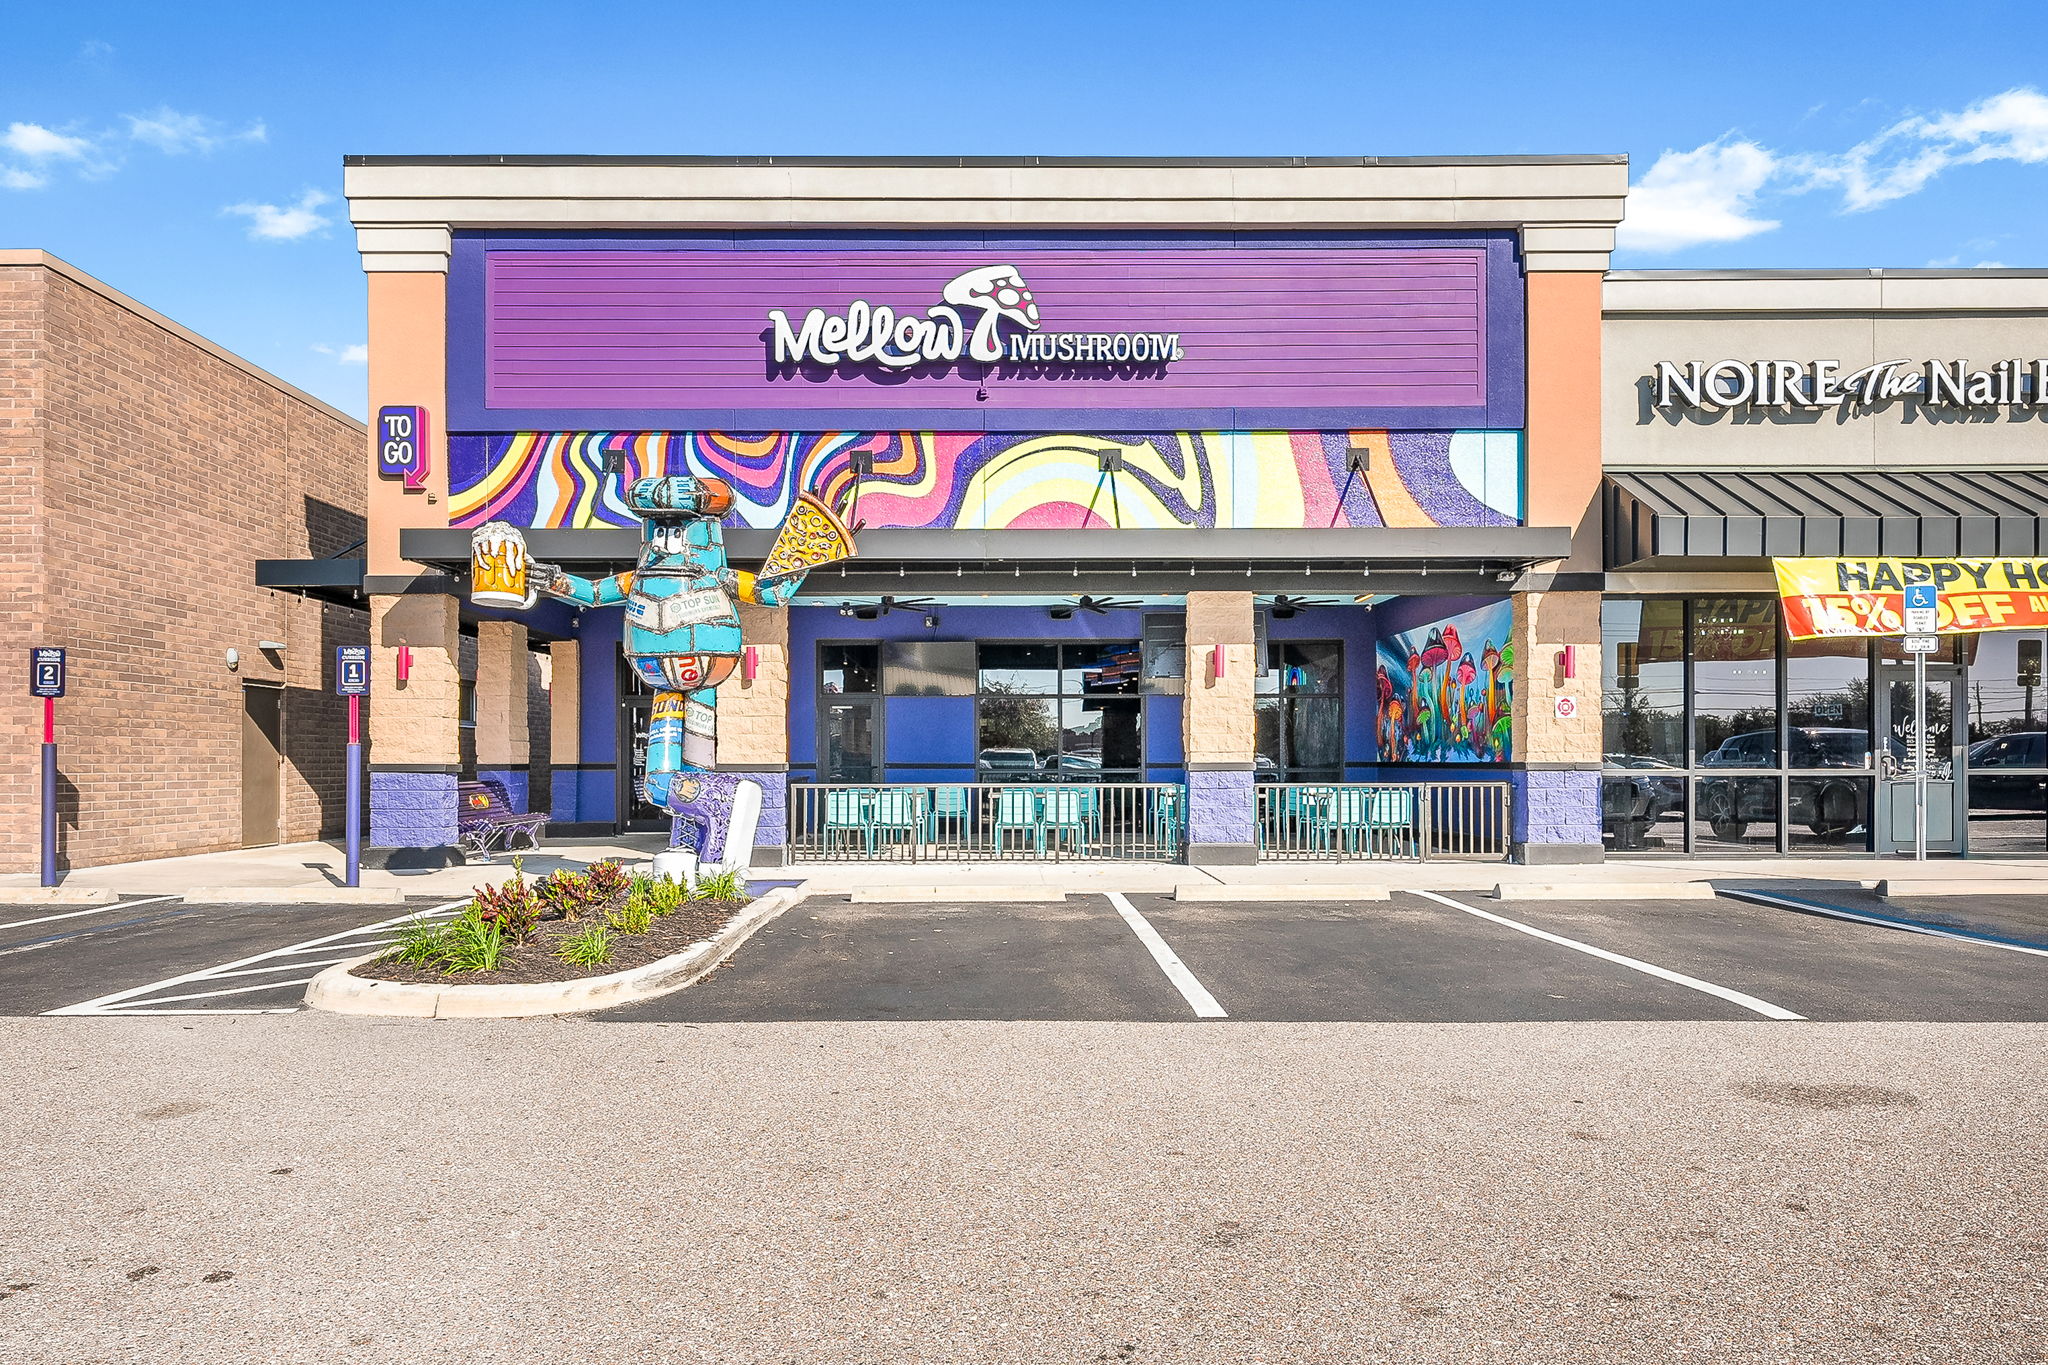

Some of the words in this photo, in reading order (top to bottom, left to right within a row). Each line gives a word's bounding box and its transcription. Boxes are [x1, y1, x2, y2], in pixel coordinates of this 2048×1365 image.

[768, 300, 964, 366] Mellow
[1009, 333, 1180, 362] MUSHROOM
[1657, 359, 1845, 407] NOIRE
[1832, 359, 1922, 405] The
[1926, 358, 2023, 407] Nail
[384, 415, 412, 437] TO
[383, 441, 412, 464] GO
[1836, 562, 1992, 591] HAPPY
[682, 597, 701, 609] TOP
[1801, 596, 1902, 632] 15%
[43, 665, 54, 680] 2
[349, 663, 359, 678] 1
[1893, 715, 1949, 737] Welme
